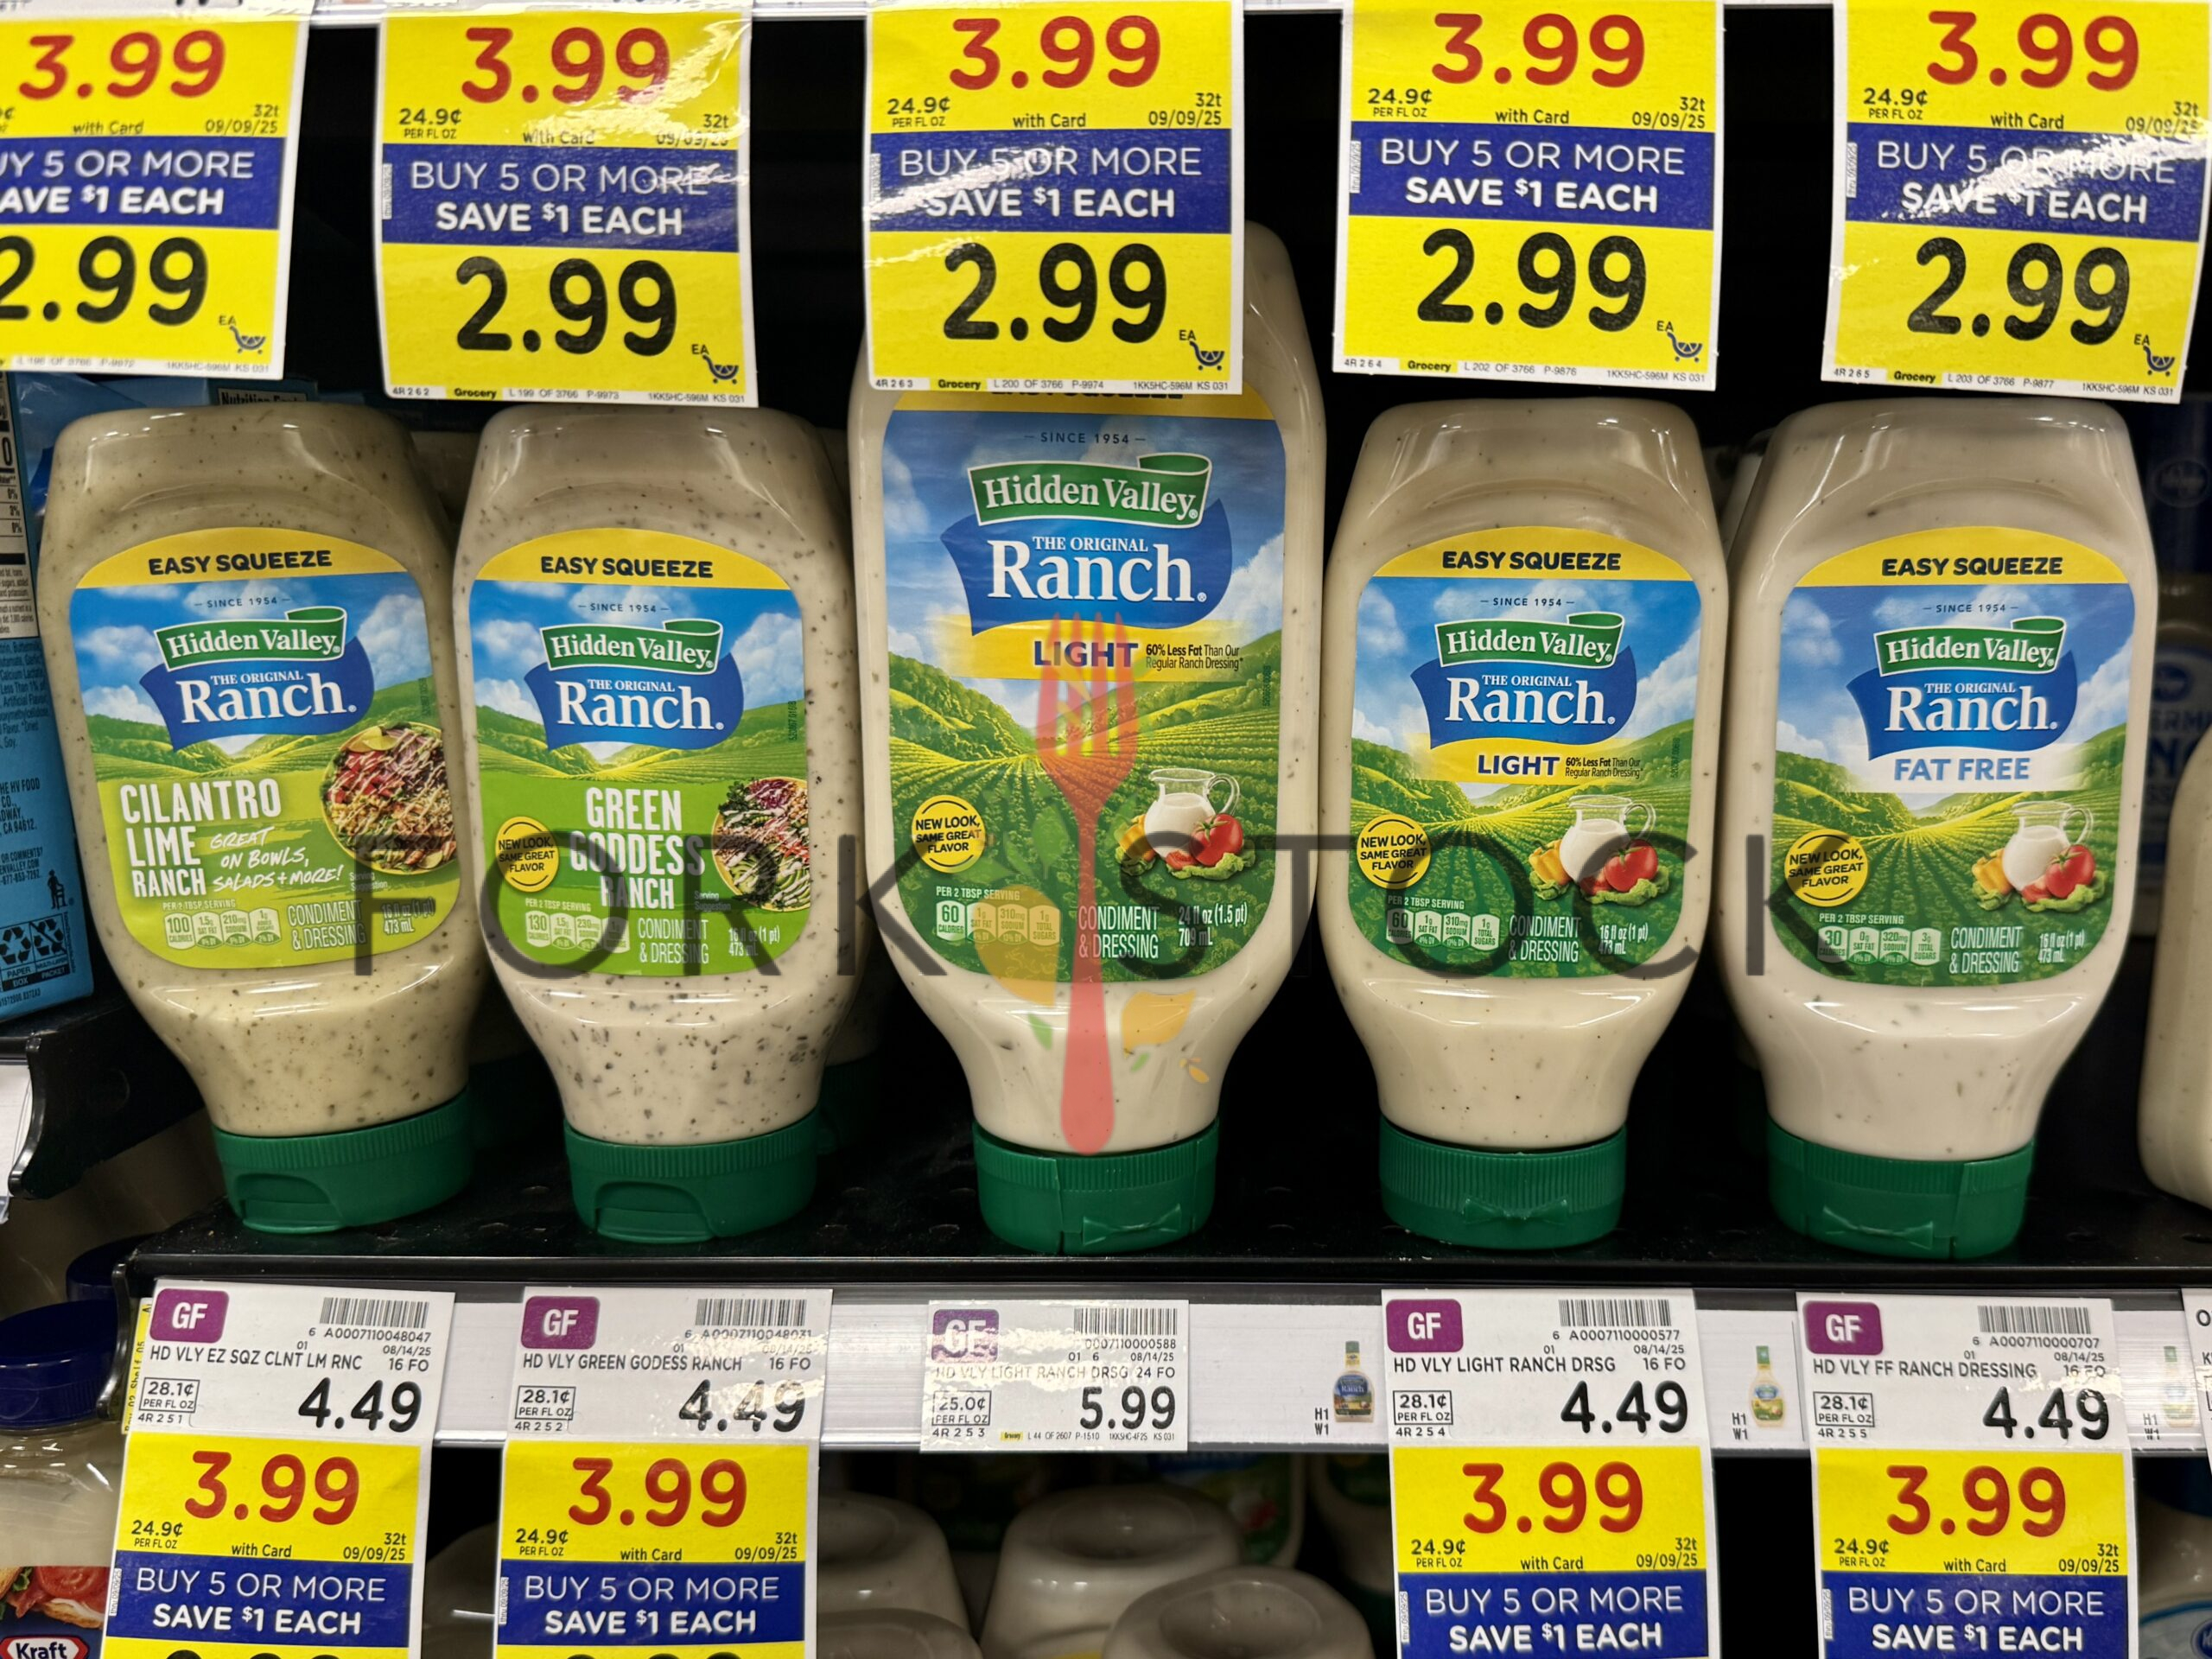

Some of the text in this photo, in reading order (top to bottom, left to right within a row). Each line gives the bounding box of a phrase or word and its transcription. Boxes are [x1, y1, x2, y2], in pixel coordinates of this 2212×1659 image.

[950, 16, 1161, 90] 3.99
[1432, 13, 1645, 87] 3.99
[1927, 11, 2139, 91] 3.99
[19, 30, 226, 100] 3.99
[461, 27, 671, 105] 3.99
[887, 97, 950, 115] 24.9¢
[1013, 113, 1087, 128] with Card
[1148, 111, 1222, 127] 09/09/25
[900, 148, 1203, 177] BUY 5 OR MORE
[1380, 138, 1686, 175] BUY 5 OR MORE
[410, 161, 709, 195] BUY 5 OR MORE
[925, 188, 1175, 218] SAVE $1 EACH
[1405, 177, 1657, 213] SAVE $1 EACH
[435, 202, 683, 236] SAVE $1 EACH
[0, 235, 208, 327] 2.99
[944, 242, 1167, 343] 2.99
[1417, 228, 1646, 332] 2.99
[1907, 237, 2130, 346] 2.99
[455, 256, 677, 356] 2.99
[938, 379, 981, 391] Grocery
[1040, 431, 1129, 444] SINCE 1954
[982, 474, 1197, 520] Hidden Valley
[1033, 536, 1148, 553] THE ORIGINAL
[148, 550, 333, 576] EASY SQUEEZE
[540, 556, 714, 578] EASY SQUEEZE
[987, 539, 1195, 603] Ranch
[1442, 550, 1621, 570] EASY SQUEEZE
[1882, 557, 2063, 576] EASY SQUEEZE
[207, 595, 278, 609] SINCE 1954
[589, 603, 658, 613] SINCE 1954
[1493, 597, 1562, 607] SINCE 1954
[1936, 603, 2006, 613] SINCE 1954
[166, 628, 337, 658] Hidden Valley
[550, 632, 713, 667] Hidden Valley
[1034, 640, 1138, 668] LIGHT
[1146, 644, 1240, 657] 60% Less Fat Than Our
[1446, 629, 1611, 664] Hidden Valley
[1885, 637, 2055, 669] Hidden Valley
[211, 670, 304, 686] THE ORIGINAL
[588, 678, 676, 693] THE ORIGINAL
[1482, 674, 1572, 687] THE ORIGINAL
[1924, 682, 2016, 695] THE ORIGINAL
[175, 671, 347, 725] Ranch
[555, 681, 715, 731] Ranch
[1444, 677, 1606, 726] Ranch
[1885, 685, 2048, 733] Ranch
[1478, 755, 1560, 776] LIGHT
[1894, 757, 2031, 781] FAT FREE
[10, 779, 40, 792] HV FOOD
[119, 779, 282, 823] CILANTRO
[586, 787, 683, 831] GREEN
[915, 816, 981, 830] NEW LOOK,
[916, 830, 982, 843] SAME GREAT
[125, 826, 202, 867] LIME
[569, 831, 706, 875] GODDESS
[927, 842, 969, 854] FLAVOR
[131, 868, 207, 898] RANCH
[600, 875, 676, 910] RANCH
[1950, 926, 2024, 950] CONDIMENT
[6, 966, 31, 978] PAPER
[1949, 951, 2021, 974] & DRESSING
[172, 1302, 207, 1330] GF
[543, 1309, 579, 1336] GF
[1407, 1313, 1441, 1339] GF
[1825, 1313, 1862, 1341] GF
[149, 1346, 363, 1370] HD VLY EZ SQZ CLNT LM RNC
[524, 1355, 742, 1371] HD VLY GREEN GODESS RANCH
[1394, 1357, 1616, 1373] HD VLY LIGHT RANCH DRSG
[1814, 1359, 2037, 1378] HD VLY FF RANCH DRESSING
[298, 1376, 423, 1433] 4.49
[678, 1379, 806, 1433] 4.49
[1079, 1386, 1176, 1430] 5.99
[1560, 1380, 1688, 1433] 4.49
[1982, 1386, 2109, 1440] 4.49
[185, 1451, 359, 1525] 3.99
[569, 1458, 747, 1527] 3.99
[1462, 1461, 1643, 1534] 3.99
[1886, 1465, 2066, 1537] 3.99
[1427, 1586, 1683, 1613] BUY 5 OR MORE
[16, 1641, 67, 1659] Kraft
[1449, 1622, 1662, 1651] SAVE $1 EACH
